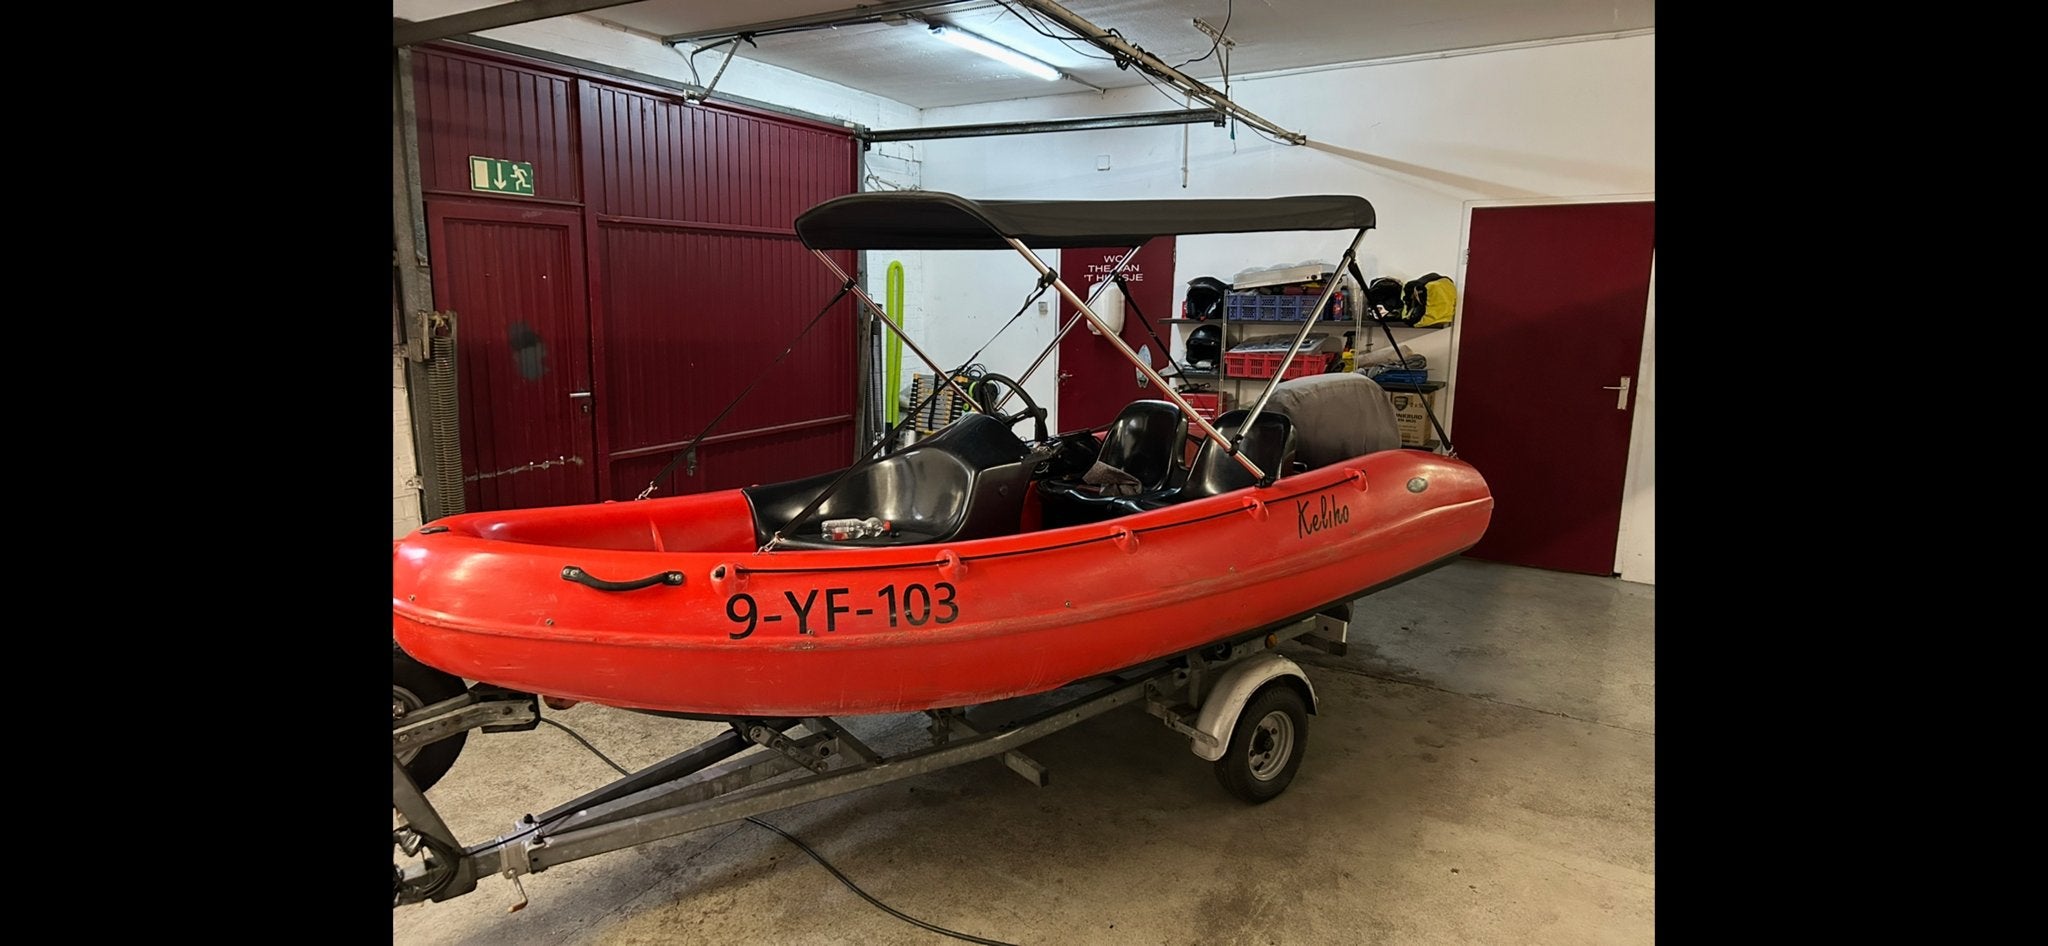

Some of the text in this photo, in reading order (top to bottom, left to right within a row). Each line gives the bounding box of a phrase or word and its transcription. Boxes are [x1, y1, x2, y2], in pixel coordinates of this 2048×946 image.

[1103, 255, 1123, 263] WC
[1088, 264, 1140, 273] THE AN
[1096, 273, 1143, 281] HSJE
[726, 582, 959, 640] 9-YF-103
